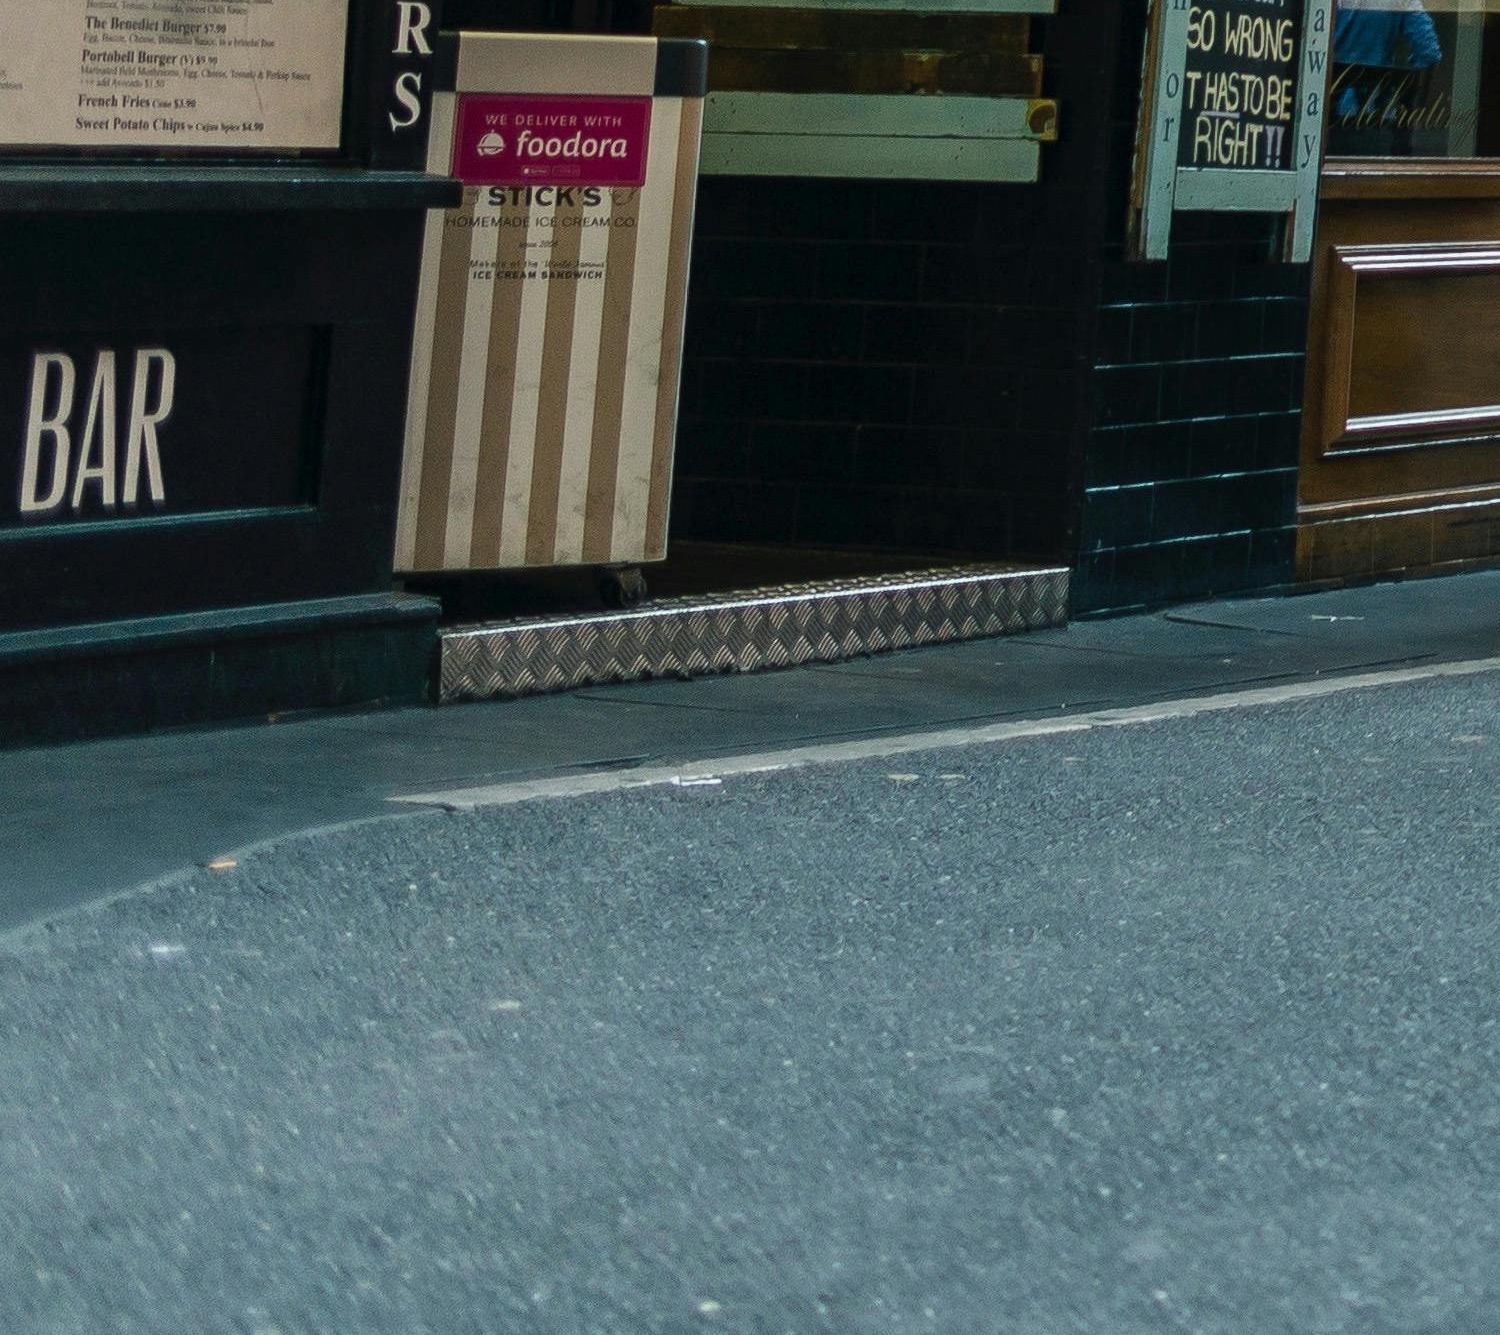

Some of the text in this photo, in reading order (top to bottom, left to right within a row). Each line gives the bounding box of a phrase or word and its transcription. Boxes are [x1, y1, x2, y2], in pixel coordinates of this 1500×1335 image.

[84, 14, 107, 30] The
[110, 16, 160, 32] Benedict
[162, 19, 202, 36] Burger
[1186, 6, 1294, 65] SO WRONG
[82, 48, 135, 64] Portobell
[137, 51, 178, 67] Burger
[77, 93, 118, 109] French
[121, 94, 151, 109] Fries
[1203, 72, 1292, 122] HAS TO BE
[75, 116, 110, 131] Sweet
[112, 116, 150, 131] Potato
[152, 117, 186, 134] Chips
[485, 114, 623, 128] WE DELIVER WITH
[515, 130, 628, 158] foodora
[487, 185, 603, 208] STICK'S
[445, 216, 531, 229] HOMEMADE
[535, 216, 558, 229] ICE
[561, 216, 611, 229] CREAM
[472, 270, 604, 281] ICE CREAM SANDWICH
[19, 348, 177, 514] BAR
